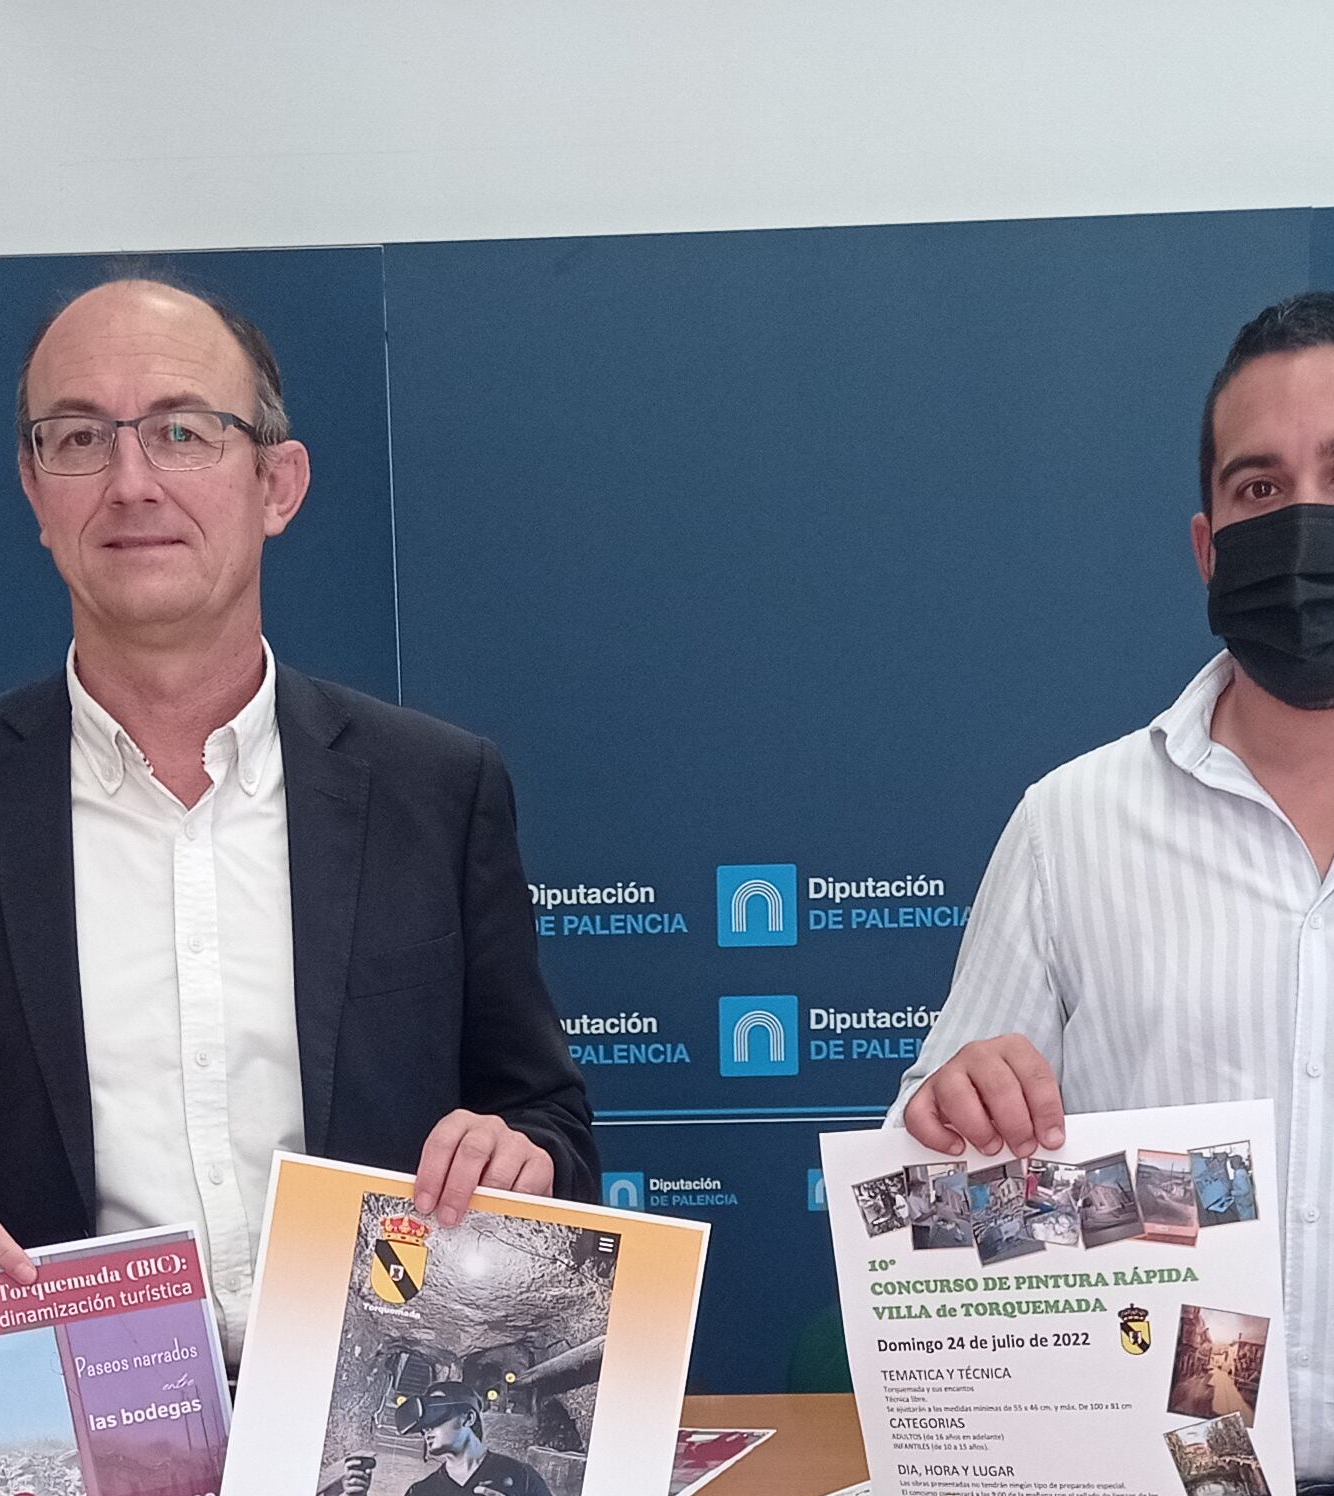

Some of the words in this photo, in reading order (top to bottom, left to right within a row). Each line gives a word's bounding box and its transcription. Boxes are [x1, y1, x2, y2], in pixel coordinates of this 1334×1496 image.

[808, 875, 944, 902] Diputación
[535, 915, 555, 935] E
[563, 913, 688, 935] PALENCIA
[809, 909, 843, 929] DE
[560, 1012, 657, 1034] utación
[809, 1006, 940, 1033] Diputación
[568, 1043, 690, 1064] PALENCIA
[810, 1040, 844, 1059] DE
[852, 1038, 922, 1060] PALE
[649, 1177, 721, 1193] Diputación
[650, 1195, 668, 1206] DE
[672, 1194, 738, 1206] PALENCIA
[126, 1254, 187, 1280] (BIC):
[870, 1277, 979, 1296] CONCURSO
[982, 1276, 1011, 1291] DE
[1013, 1272, 1109, 1290] PINTURA
[1112, 1266, 1199, 1286] RÁPIDA
[0, 1292, 115, 1327] dinamización
[119, 1282, 192, 1306] turística
[872, 1304, 932, 1320] VILLA
[935, 1303, 957, 1318] de
[960, 1297, 1107, 1318] TORQUEMADA
[877, 1337, 943, 1354] Domingo
[946, 1336, 965, 1350] 24
[969, 1335, 988, 1349] de
[991, 1334, 1025, 1352] julio
[1029, 1333, 1048, 1347] de
[1052, 1332, 1091, 1347] 2022
[75, 1356, 129, 1378] Paseos
[133, 1341, 197, 1368] narrados
[880, 1368, 944, 1381] TEMATICA
[946, 1368, 954, 1380] Y
[956, 1365, 1012, 1380] TÉCNICA
[89, 1411, 117, 1431] las
[120, 1398, 202, 1425] bodegas
[889, 1417, 965, 1429] CATEGORIAS
[897, 1464, 922, 1477] DIA,
[924, 1464, 960, 1476] HORA
[961, 1465, 969, 1476] Y
[972, 1465, 1014, 1477] LUGAR
